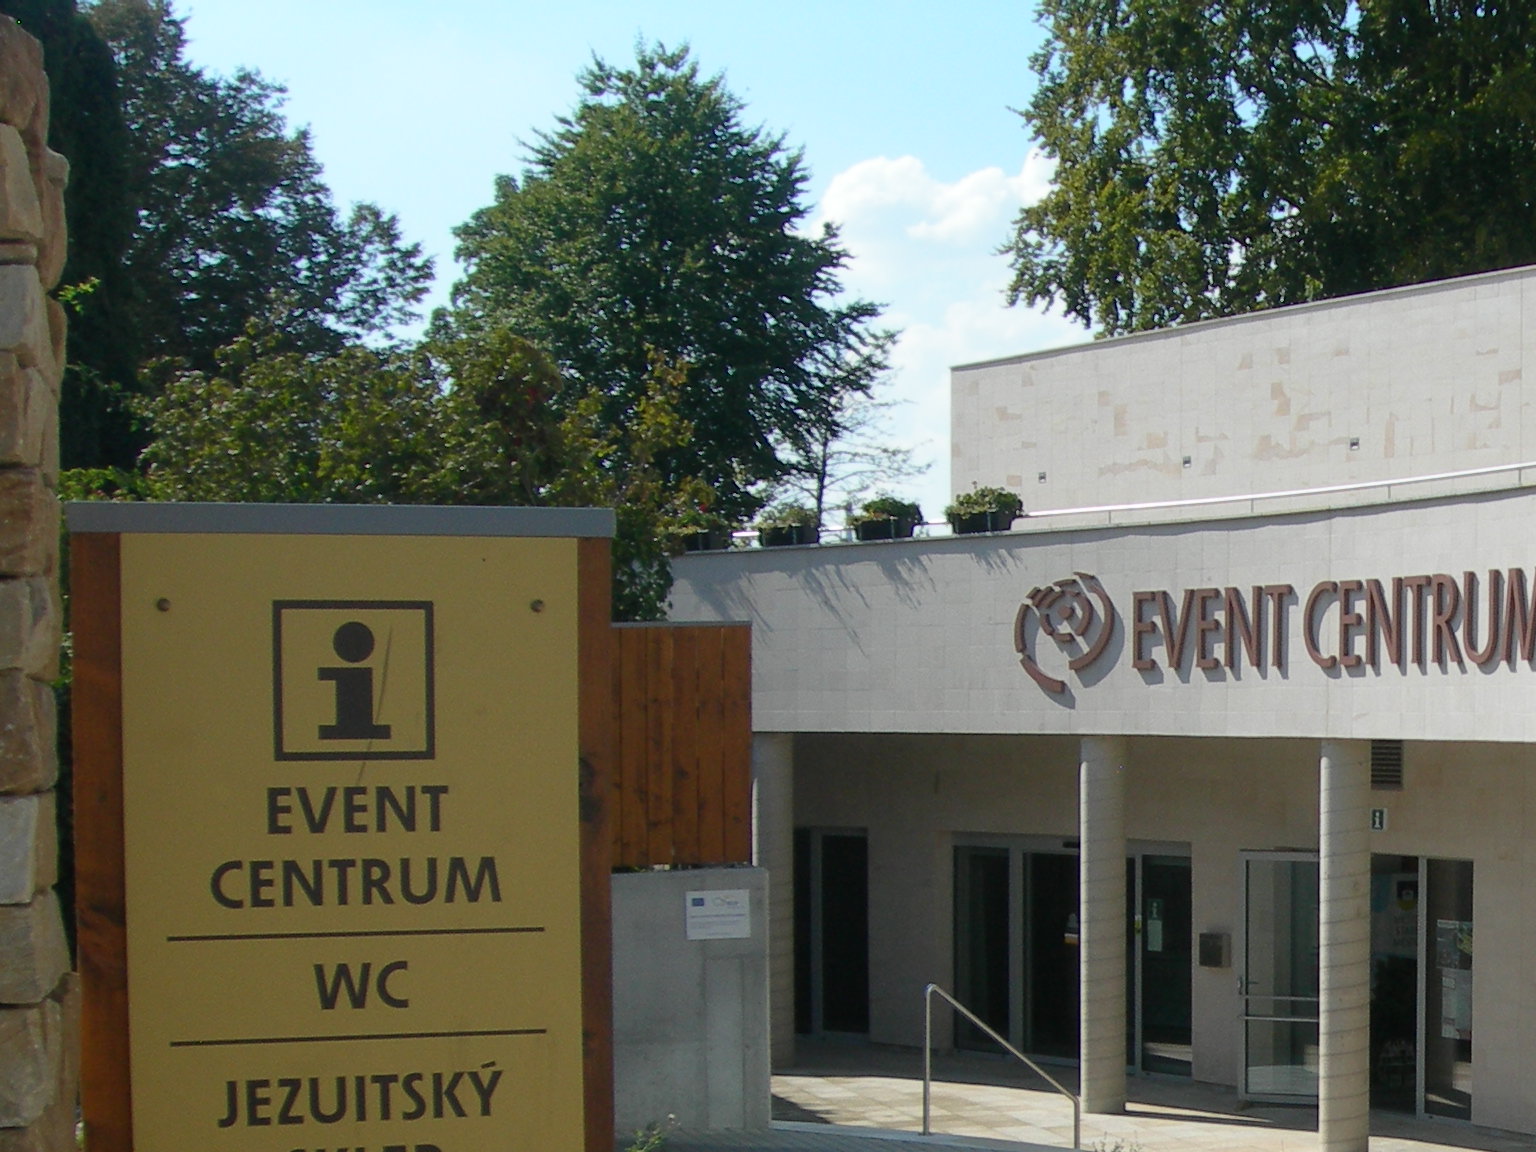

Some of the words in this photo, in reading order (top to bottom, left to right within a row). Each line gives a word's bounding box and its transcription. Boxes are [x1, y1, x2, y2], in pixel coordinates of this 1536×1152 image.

[1132, 583, 1296, 672] EVENT
[267, 785, 449, 835] EVENT
[210, 856, 502, 910] CENTRUM
[314, 960, 409, 1011] WC
[218, 1061, 503, 1129] JEZUITSKÝ
